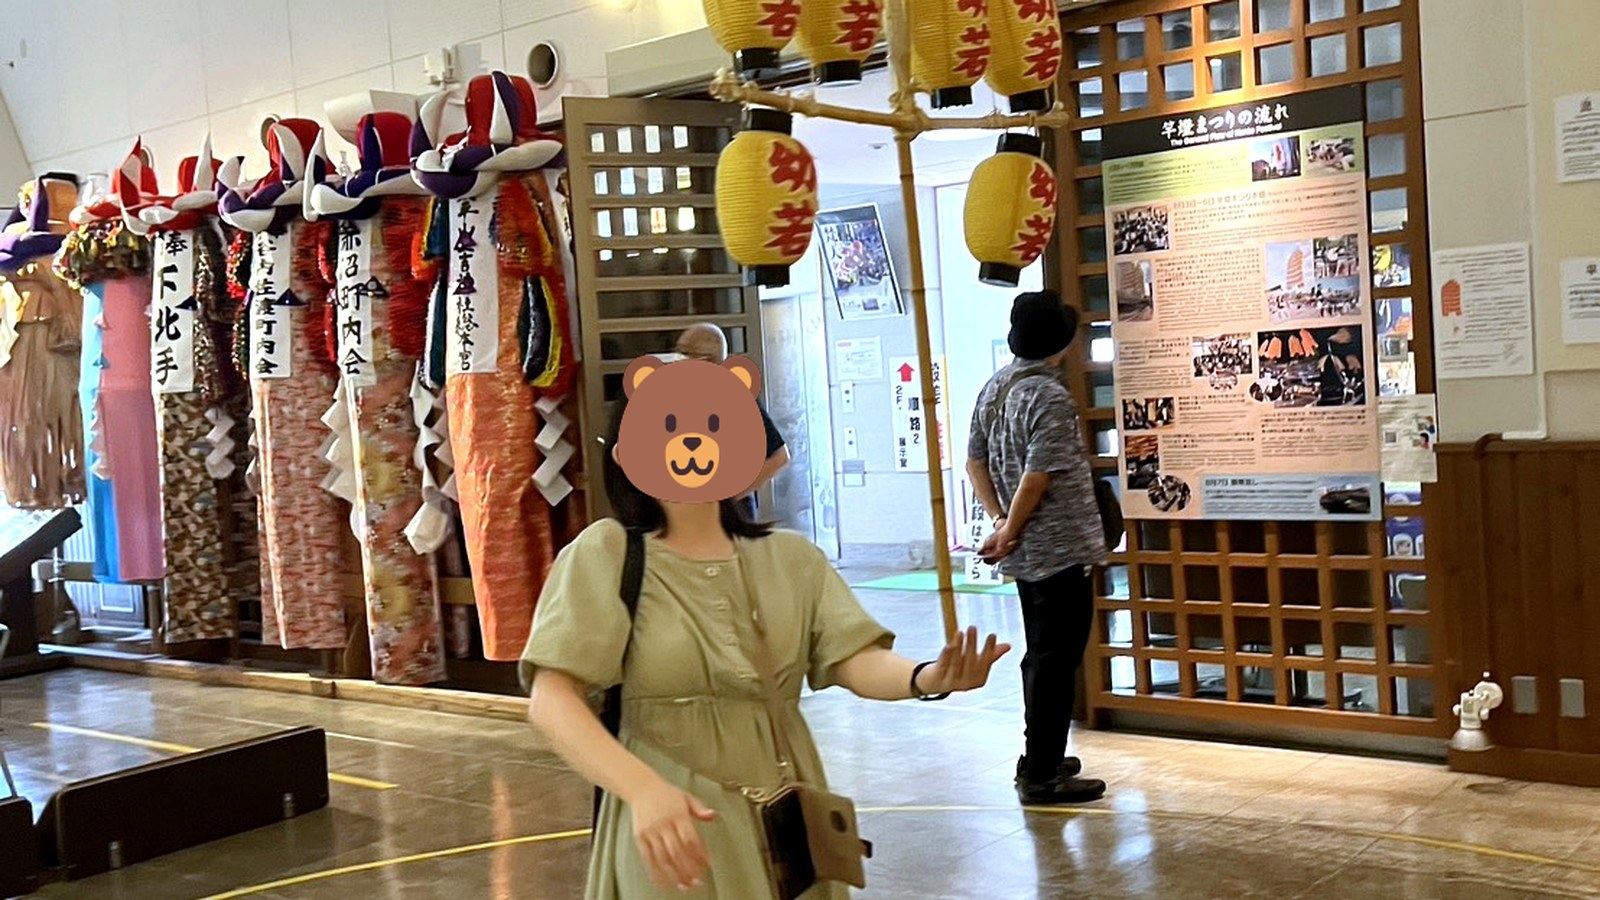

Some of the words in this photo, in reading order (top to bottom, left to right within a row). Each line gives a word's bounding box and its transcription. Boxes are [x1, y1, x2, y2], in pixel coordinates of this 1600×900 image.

[1161, 103, 1289, 140] 竿燈まつりの流れ
[764, 141, 817, 258] 幼若
[1008, 162, 1058, 262] 幼若
